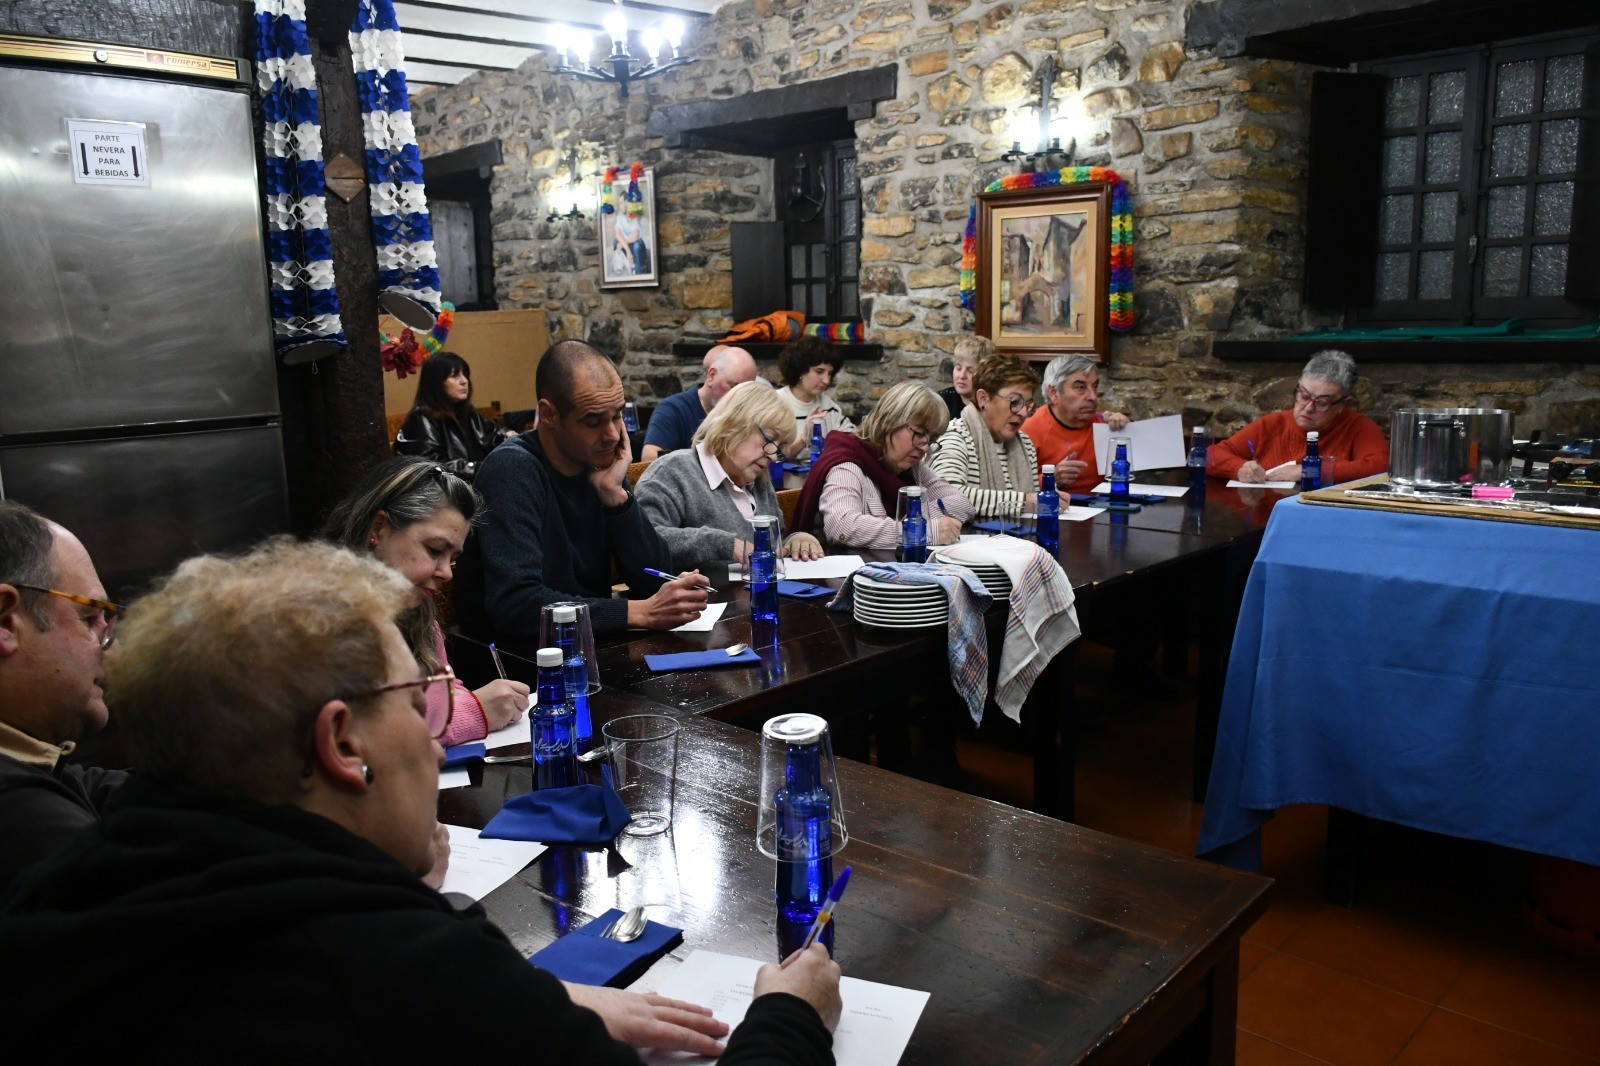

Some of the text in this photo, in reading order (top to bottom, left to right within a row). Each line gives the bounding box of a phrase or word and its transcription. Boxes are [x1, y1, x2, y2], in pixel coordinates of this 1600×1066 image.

[94, 134, 120, 142] PARTE
[93, 146, 125, 154] NEVERA
[94, 169, 129, 177] BEBIDAS
